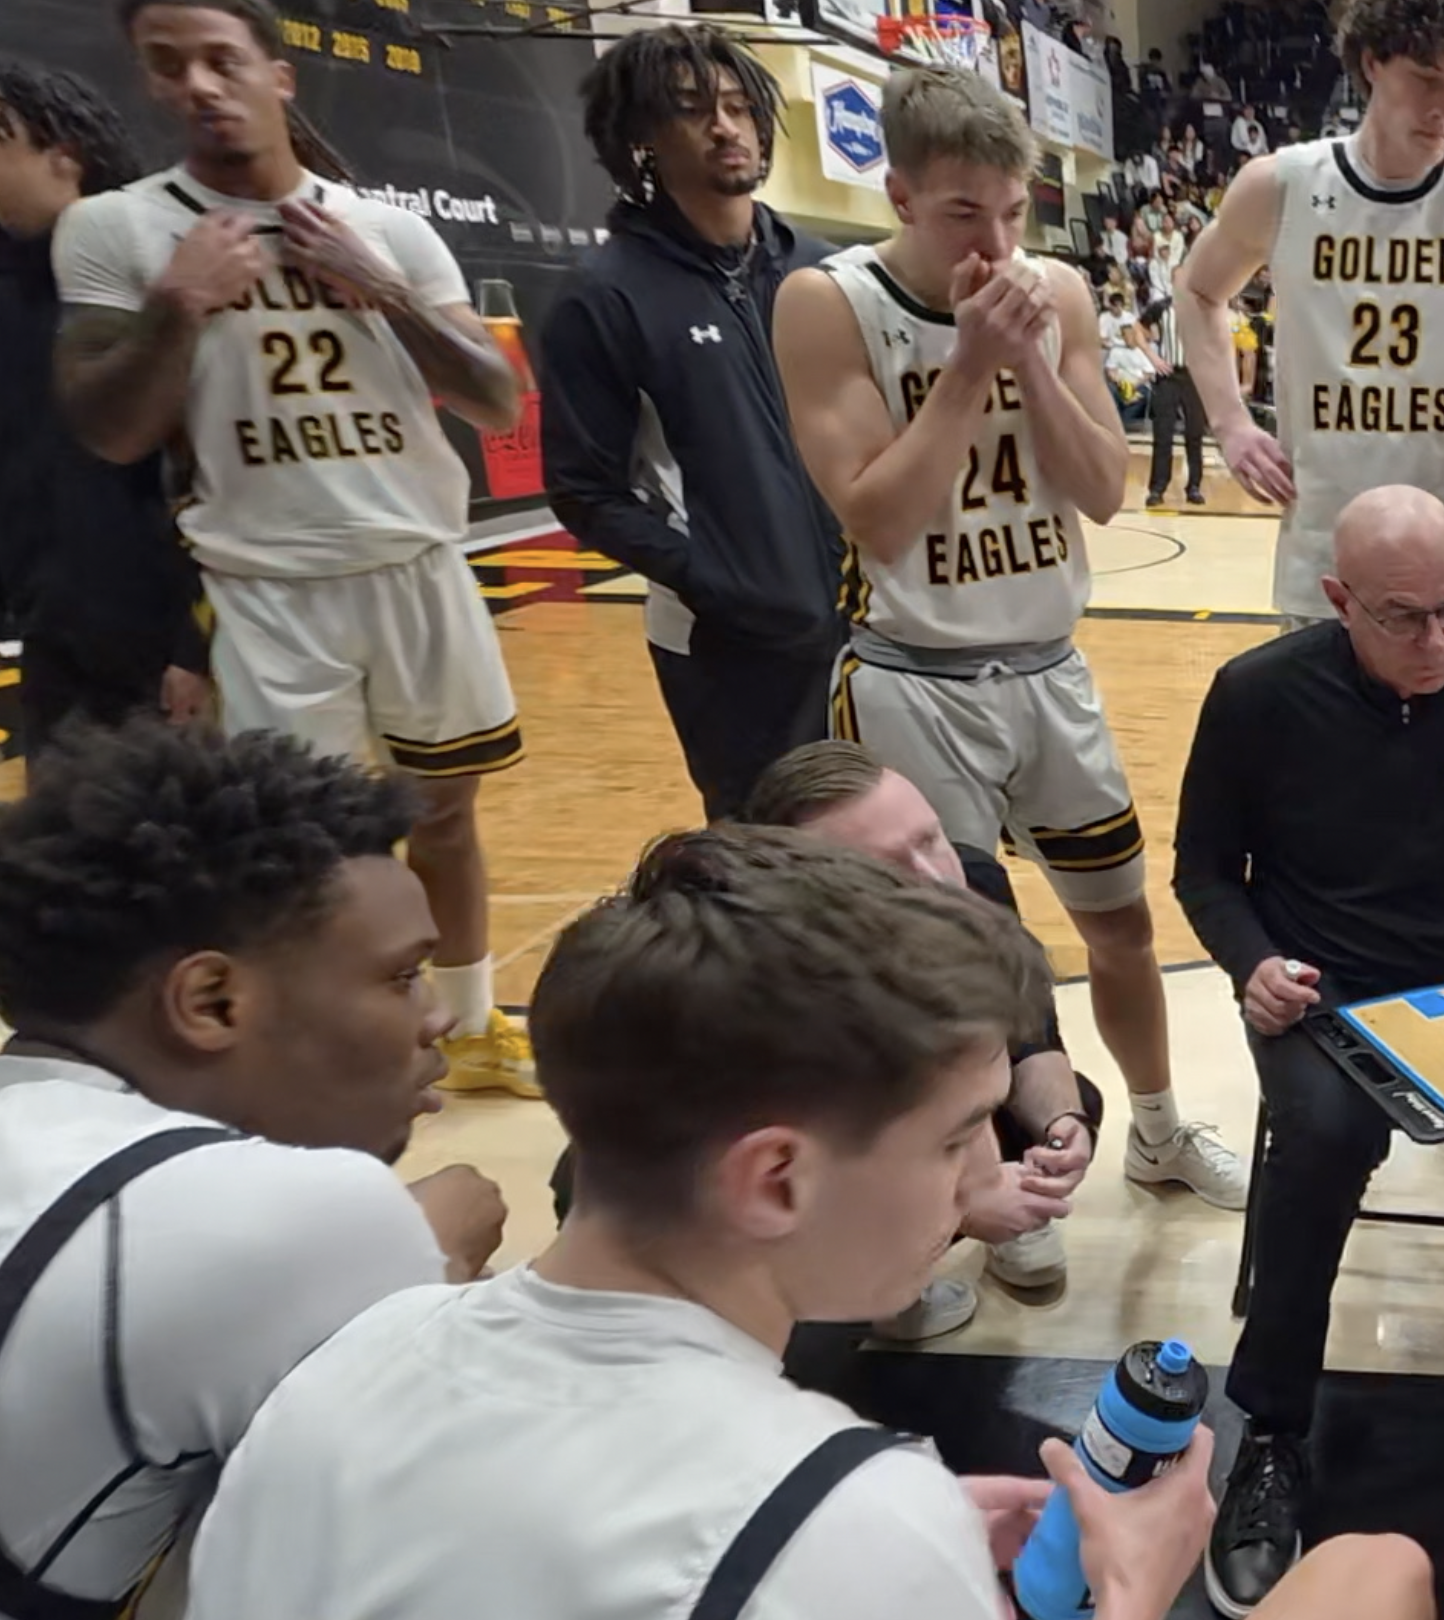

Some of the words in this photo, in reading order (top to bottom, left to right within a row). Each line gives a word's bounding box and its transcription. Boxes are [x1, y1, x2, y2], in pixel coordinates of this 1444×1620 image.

[345, 183, 431, 217] entral
[433, 189, 499, 225] Court
[261, 329, 354, 396] 22
[1349, 300, 1421, 369] 23
[235, 411, 405, 467] EAGLES
[960, 433, 1029, 512] 24
[925, 514, 1069, 586] EAGLES
